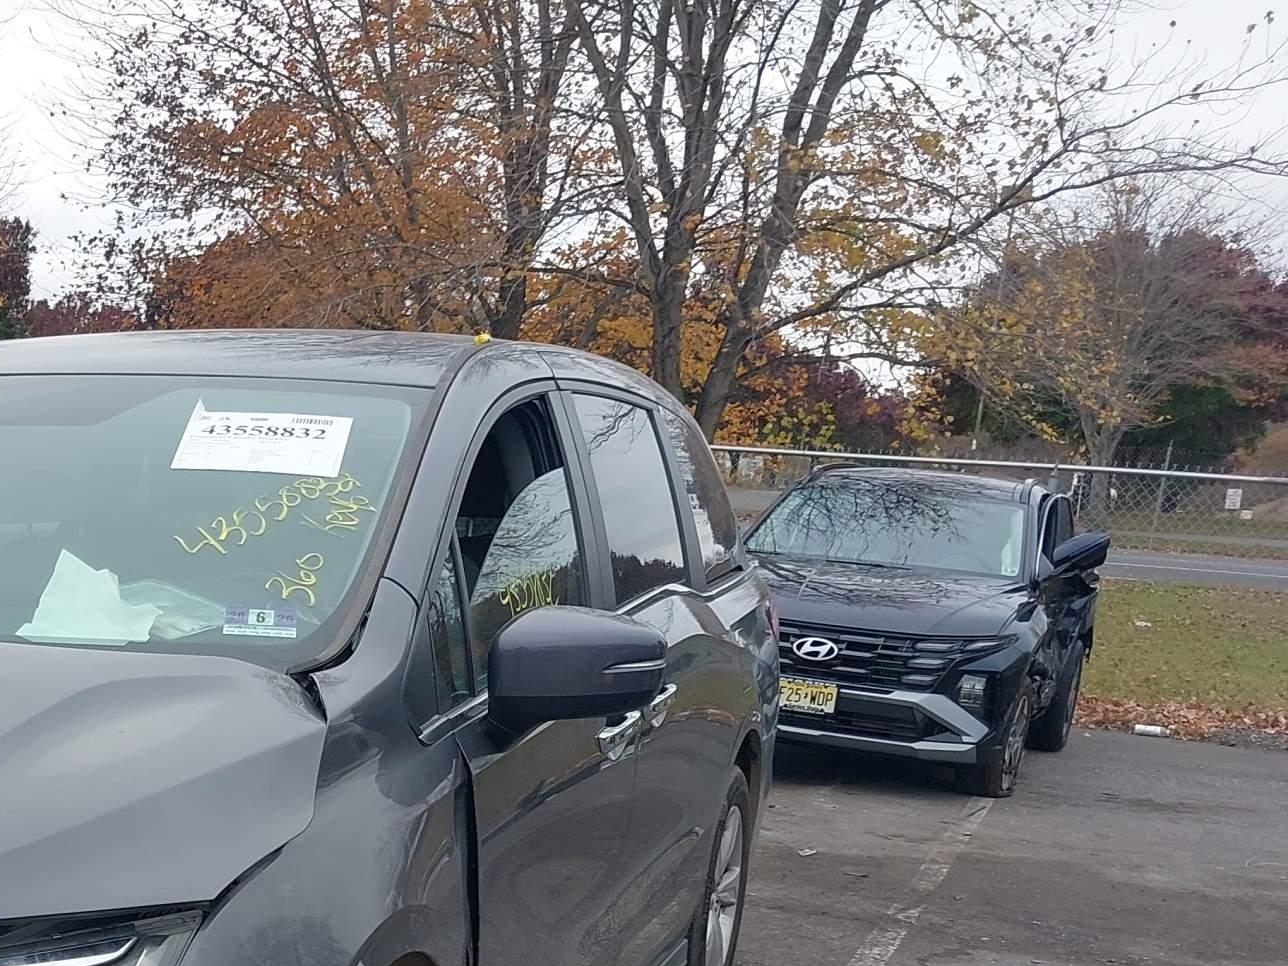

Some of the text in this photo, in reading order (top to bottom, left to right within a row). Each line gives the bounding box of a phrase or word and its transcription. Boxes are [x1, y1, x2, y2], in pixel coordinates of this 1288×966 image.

[201, 424, 328, 440] 43558832
[265, 552, 324, 607] 360
[256, 611, 267, 624] 6
